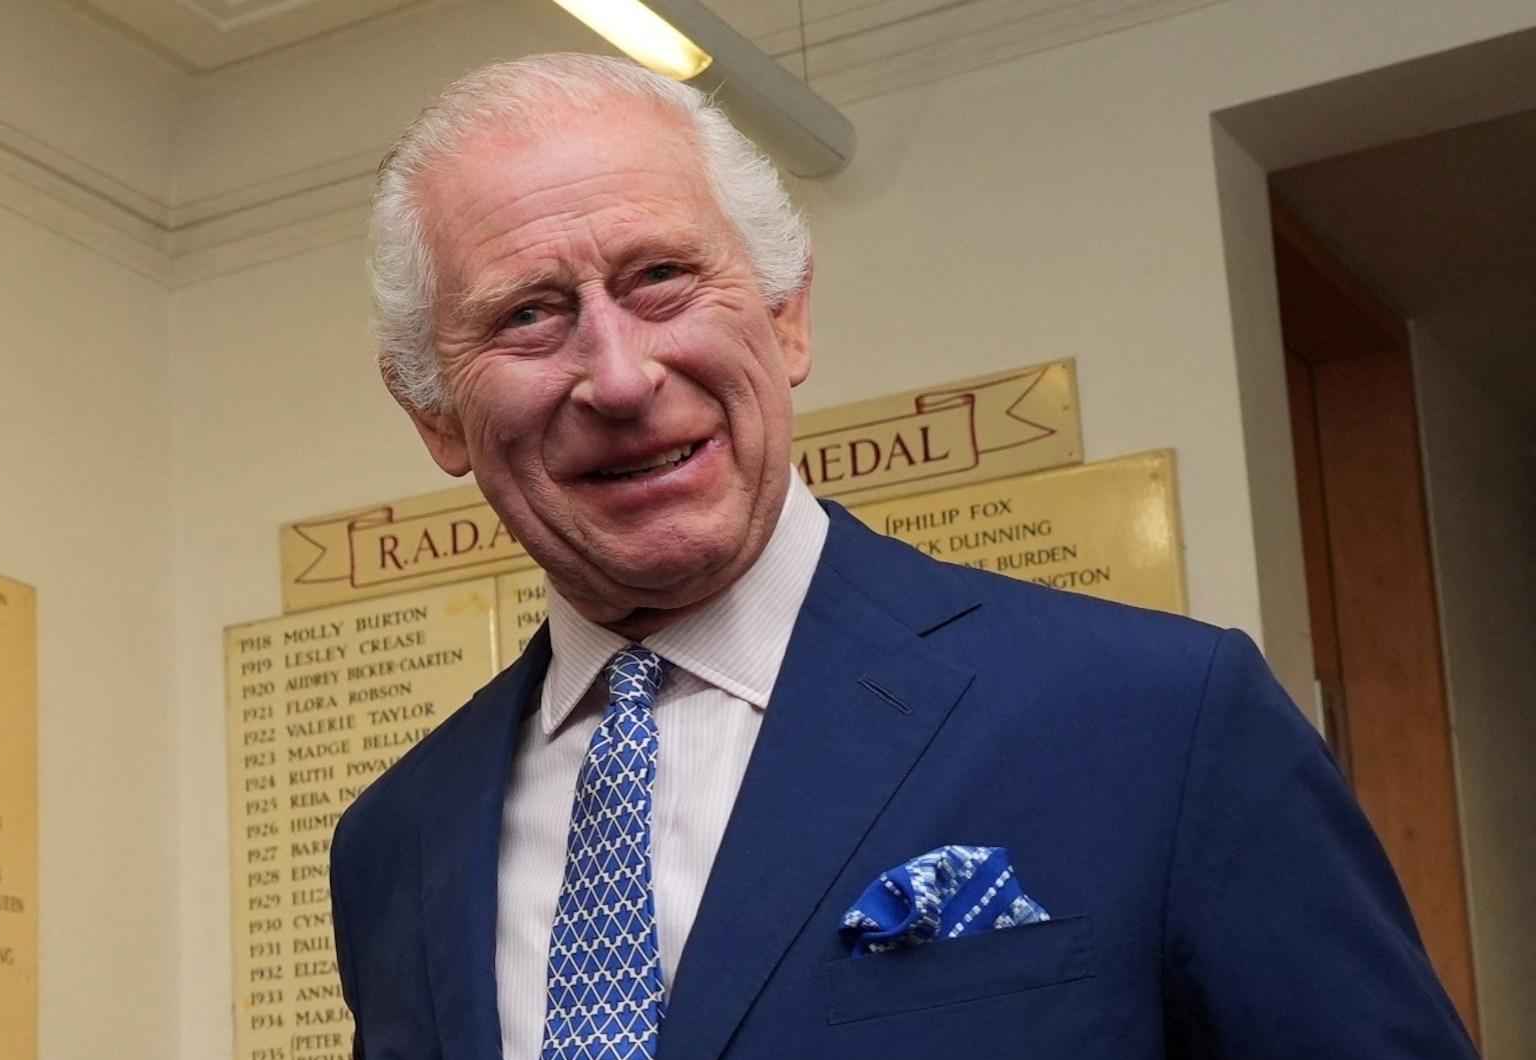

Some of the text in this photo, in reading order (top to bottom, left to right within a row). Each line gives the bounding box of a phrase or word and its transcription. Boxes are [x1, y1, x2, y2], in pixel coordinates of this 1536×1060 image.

[892, 499, 1012, 534] PHILIP FOX
[950, 520, 1052, 552] DUNNING
[997, 545, 1078, 571] BURDEN
